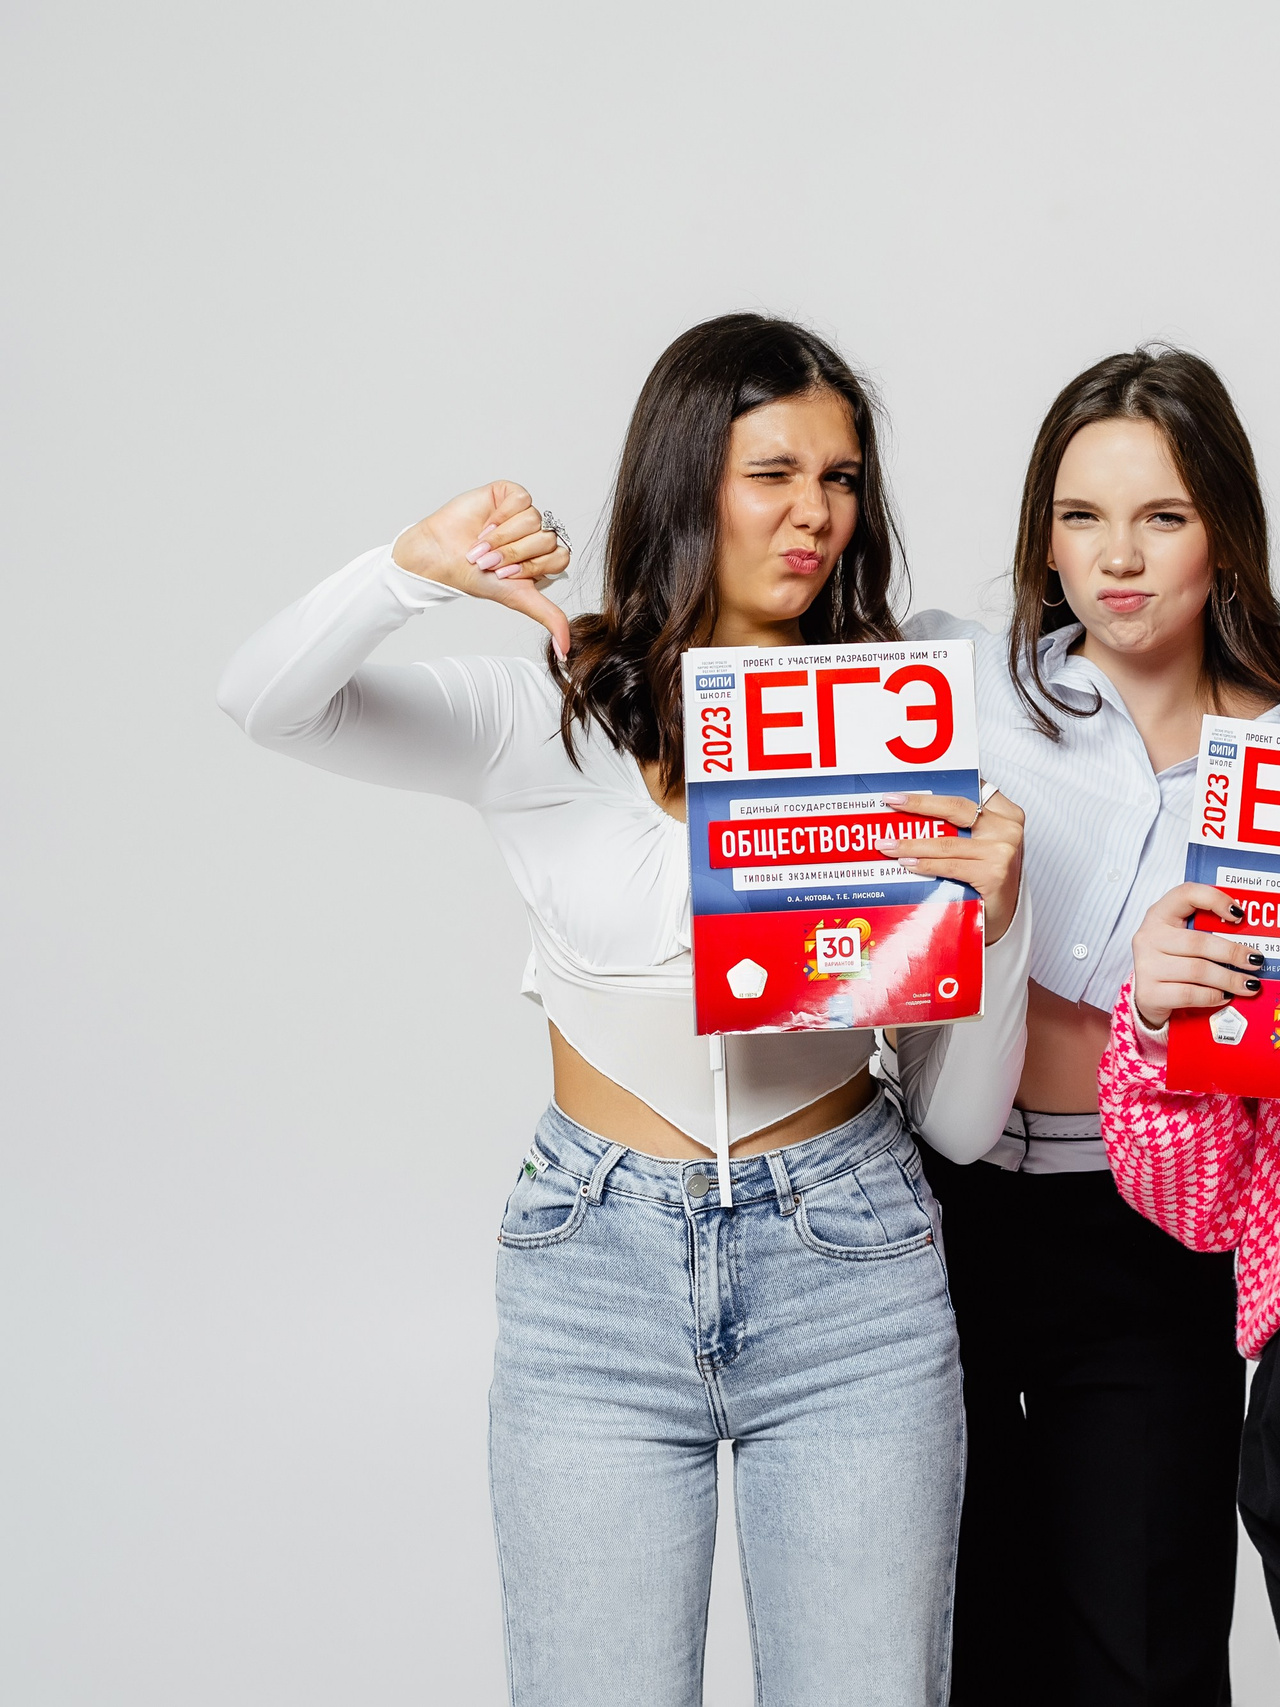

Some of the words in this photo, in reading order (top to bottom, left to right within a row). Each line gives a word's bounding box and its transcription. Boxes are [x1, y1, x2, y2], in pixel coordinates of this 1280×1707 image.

[743, 658, 774, 667] ПРОЕКТ
[787, 654, 832, 665] УЧАСТИЕМ
[836, 652, 906, 663] РАЗРАБОТЧИКОВ
[910, 651, 929, 659] КИМ
[933, 650, 948, 659] ЕГЭ
[699, 676, 732, 688] ФИПИ
[700, 691, 732, 700] ШКОЛЕ
[744, 664, 954, 771] ЕГЭ
[701, 706, 733, 773] 2023
[1245, 733, 1273, 744] ПРОЕКТ
[1210, 744, 1235, 757] ФИПИ
[1209, 759, 1233, 768] ШКОЛЕ
[740, 804, 780, 815] ЕДИНЫЙ
[784, 799, 876, 812] ГОСУДАРСТВЕННЫЙ
[1202, 773, 1230, 840] 2023
[721, 820, 945, 859] ОБЩЕСТВОЗНАНИЕ
[744, 873, 783, 883] ТИПОВЫЕ
[788, 868, 875, 881] ЭКЗАМЕНАЦИОННЫЕ
[880, 866, 914, 876] ВАРИА
[1225, 875, 1262, 886] ЕДИНЫЙ
[804, 894, 834, 902] КОТОВА,
[852, 891, 885, 899] ЛИСКОВА
[823, 936, 854, 958] 30
